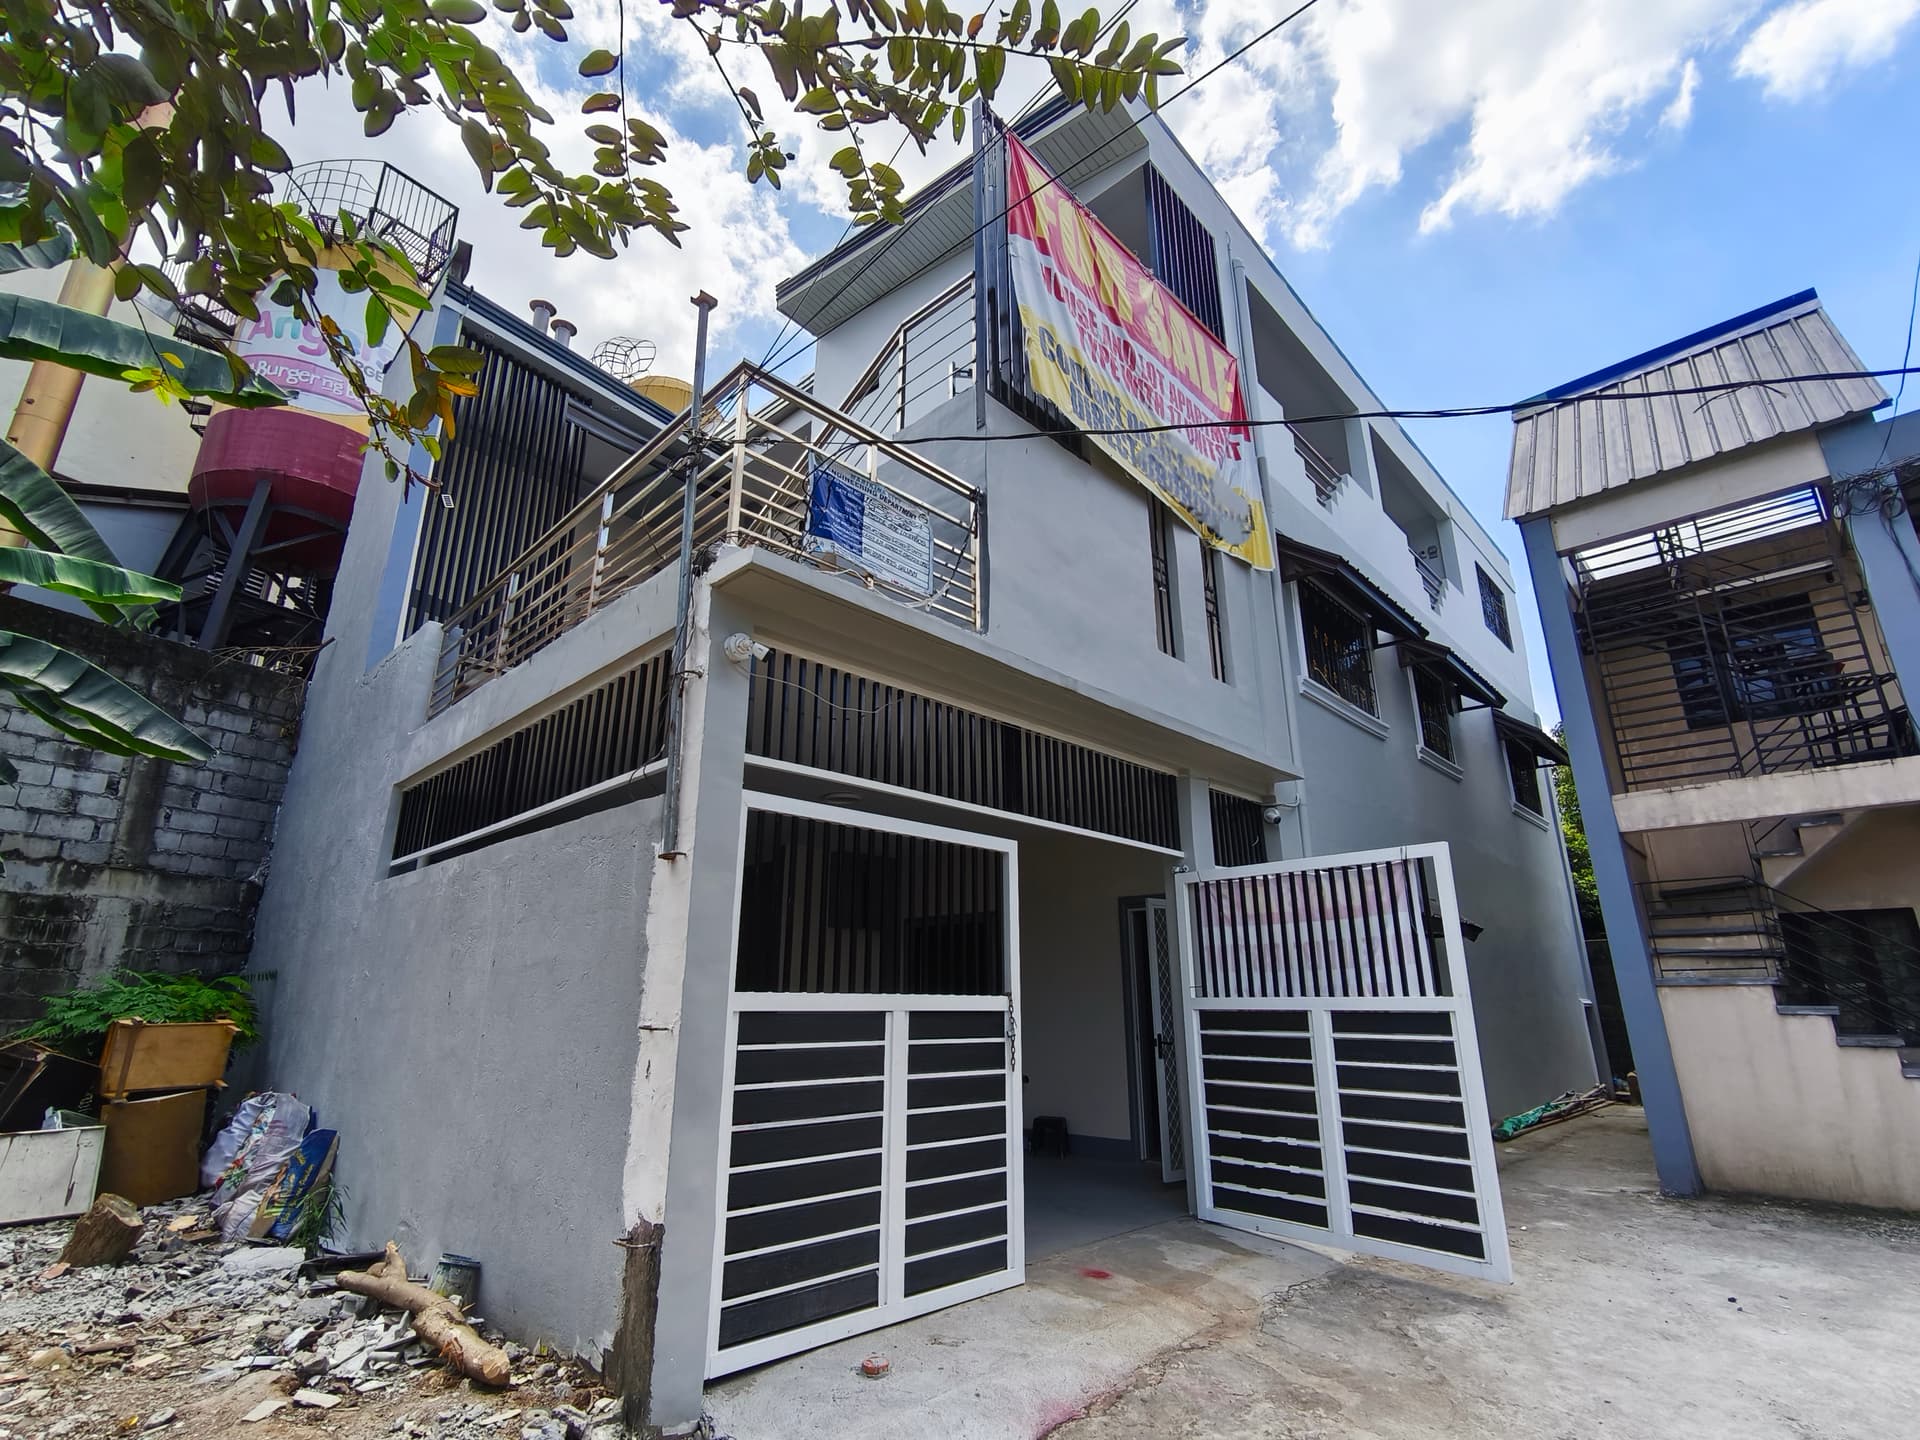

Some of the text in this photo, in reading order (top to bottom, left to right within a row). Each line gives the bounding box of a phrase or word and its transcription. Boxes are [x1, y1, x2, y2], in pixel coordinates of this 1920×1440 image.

[1023, 159, 1234, 414] FOR SALE
[1040, 262, 1098, 329] HOUSE
[1101, 321, 1136, 372] AND
[1138, 353, 1165, 396] LOT
[255, 361, 319, 384] Burger
[1077, 326, 1121, 384] TYPE
[1184, 416, 1224, 470] UNITS
[879, 494, 917, 520] DEPARTMENT
